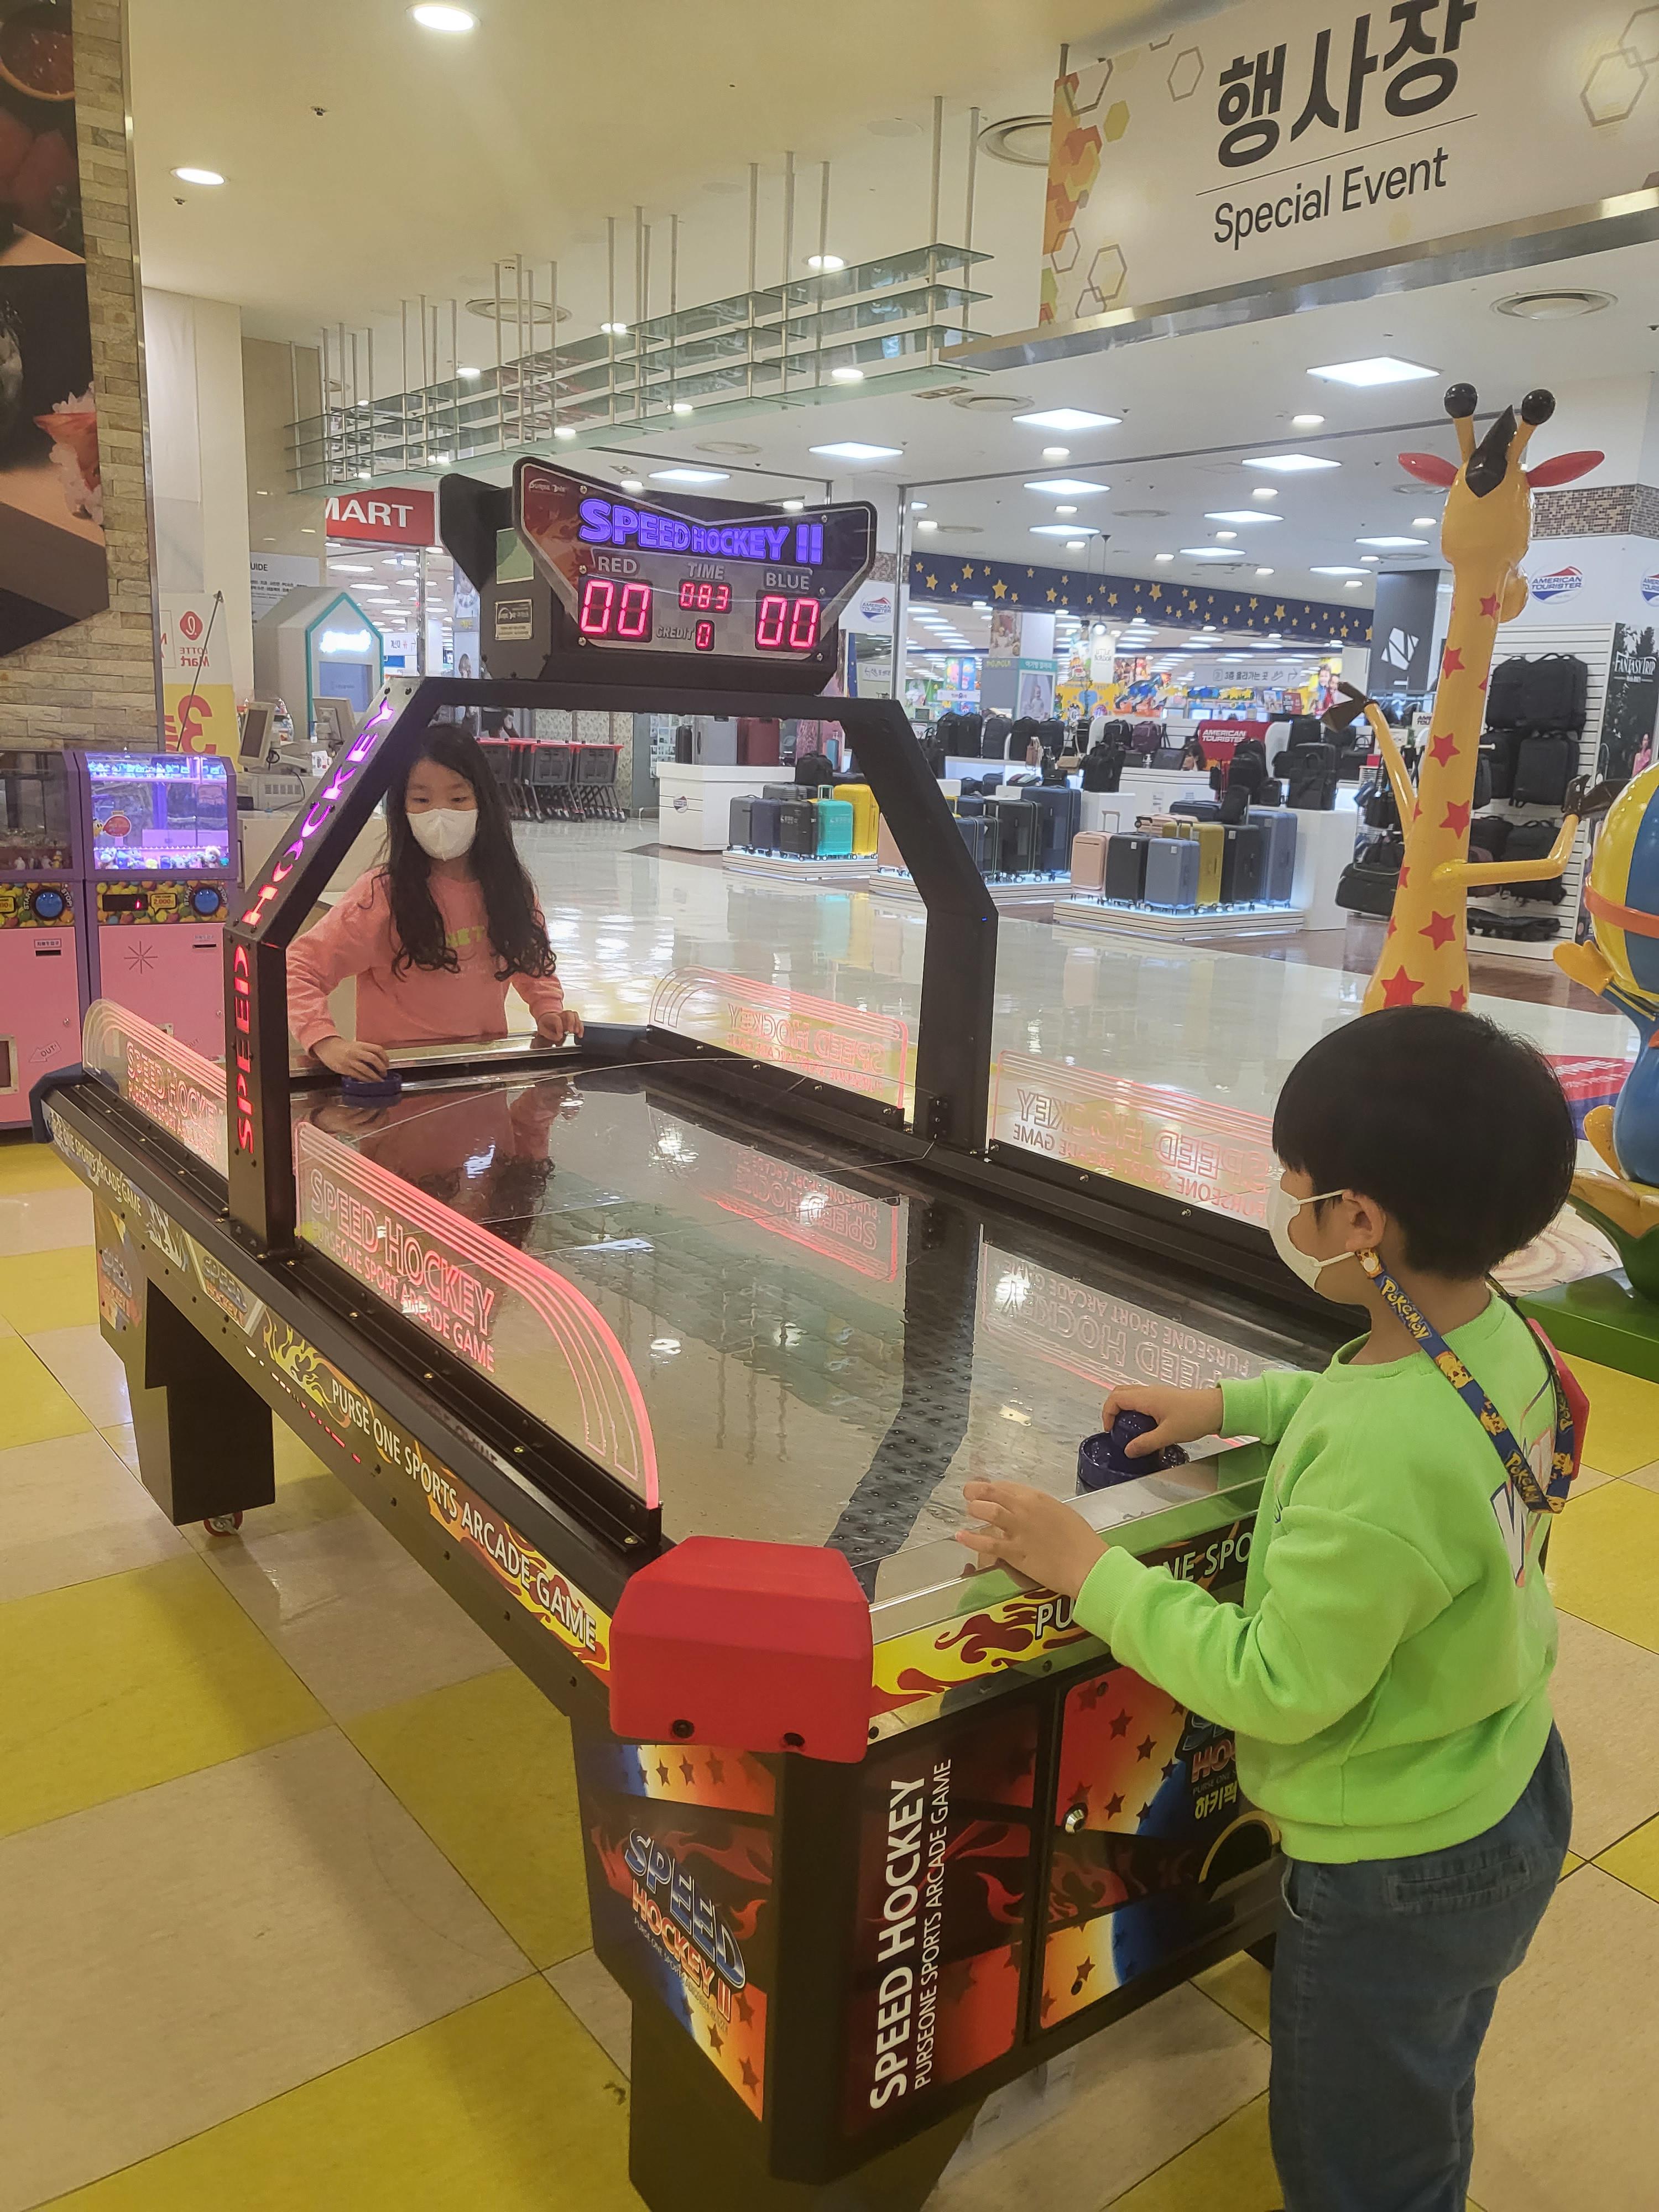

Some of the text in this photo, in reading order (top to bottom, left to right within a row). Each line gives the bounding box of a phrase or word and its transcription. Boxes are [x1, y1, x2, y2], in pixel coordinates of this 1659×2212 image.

[1217, 0, 1479, 168] 행사장
[1213, 146, 1449, 250] Special Event
[578, 497, 690, 552] SPEED
[691, 523, 790, 561] HOCKEY
[597, 556, 638, 575] RED
[680, 582, 729, 611] 083
[687, 561, 724, 581] TIME
[766, 572, 810, 591] BLUE
[581, 578, 650, 636] 00
[656, 625, 695, 640] CREDIT
[757, 596, 820, 648] 00
[23, 888, 34, 910] START
[122, 1182, 142, 1217] GAME
[311, 1168, 495, 1337] SPEED HOCKEY
[364, 1256, 399, 1300] SPORT
[453, 1321, 495, 1373] GAME
[331, 1378, 371, 1436] PURSE
[373, 1417, 401, 1465] ONE
[405, 1446, 458, 1520] SPORTS
[461, 1502, 531, 1589] ARCADE
[536, 1575, 596, 1652] GAME
[624, 1828, 747, 1990] SPEED
[632, 1879, 715, 1998] HOCKEY
[914, 1759, 952, 2090] PURSEONE SPORTS ARCADE GAME
[870, 1777, 926, 2110] SPEED HOCKEY
